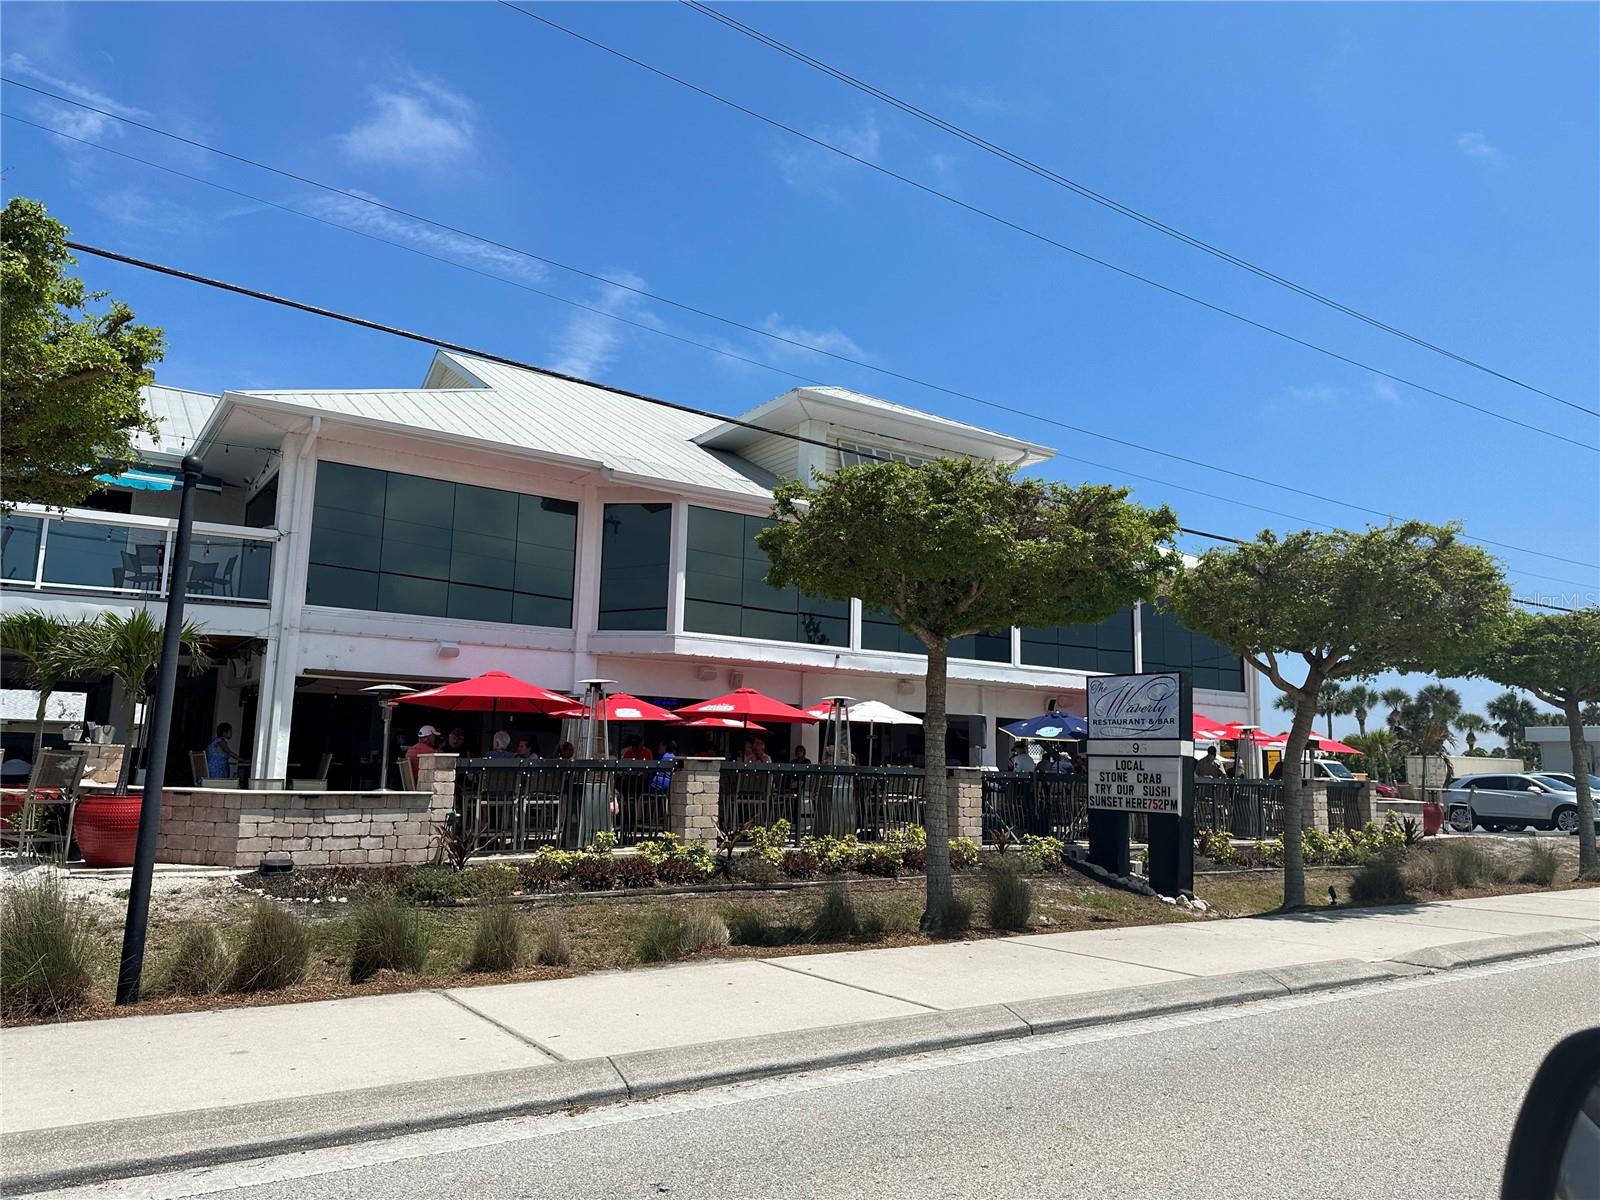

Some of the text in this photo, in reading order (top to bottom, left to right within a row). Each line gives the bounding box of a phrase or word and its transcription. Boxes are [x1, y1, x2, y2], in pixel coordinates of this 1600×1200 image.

[1090, 680, 1108, 695] The
[1094, 676, 1177, 719] Waverly
[1092, 718, 1145, 726] RESTAURANT
[1157, 717, 1175, 725] BAR
[1115, 759, 1145, 771] LOCAL
[1099, 771, 1162, 784] STONE CRAB
[1094, 783, 1171, 797] TRY OUR SUSHI
[1089, 795, 1124, 808] SUNSET
